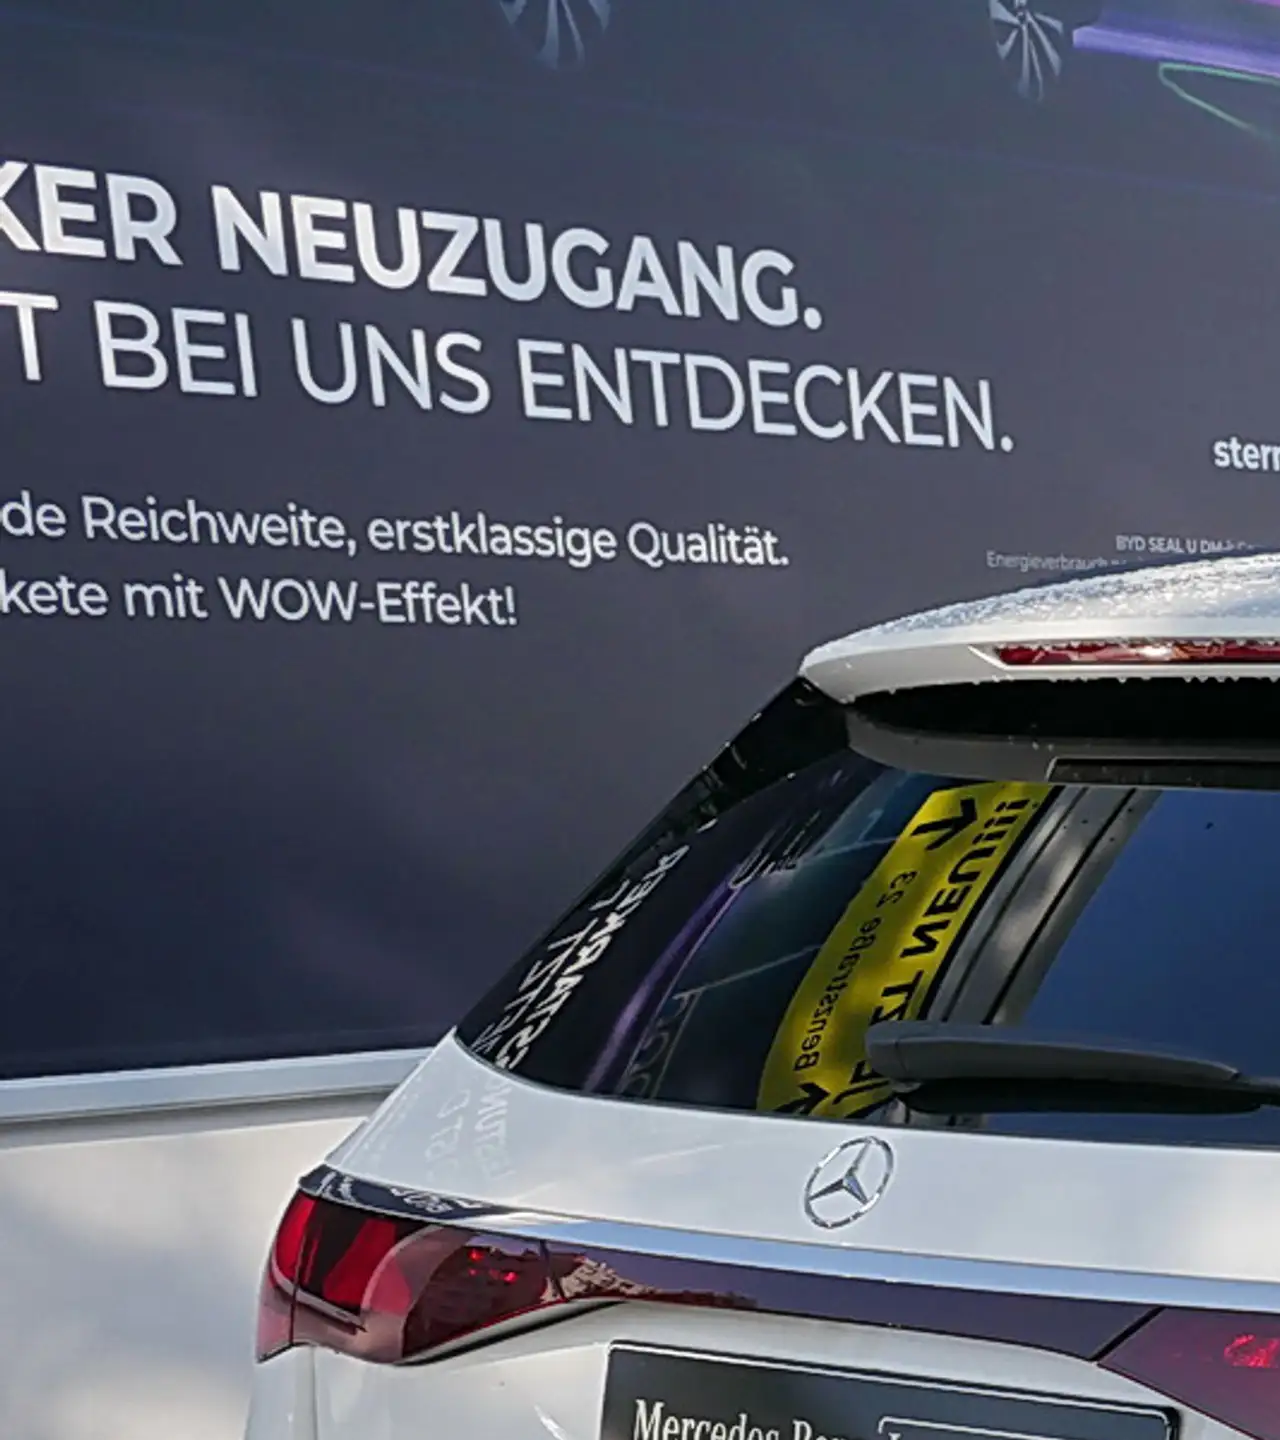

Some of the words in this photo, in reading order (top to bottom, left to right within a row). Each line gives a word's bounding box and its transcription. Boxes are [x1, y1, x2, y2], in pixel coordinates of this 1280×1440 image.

[211, 185, 822, 330] NEUZUGANG.
[0, 290, 59, 381] T
[94, 300, 257, 397] BEI
[292, 318, 490, 414] UNS
[518, 338, 1014, 452] ENTDECKEN.
[0, 489, 66, 537] de
[81, 495, 356, 557] Reichweite,
[367, 511, 618, 568] erstklassige
[627, 522, 790, 568] Qualität.
[1115, 534, 1146, 551] BYD
[1148, 536, 1185, 553] SEAL
[1186, 538, 1197, 554] U
[0, 568, 109, 616] kete
[124, 572, 208, 618] mit
[218, 577, 518, 626] WOW-Effekt!
